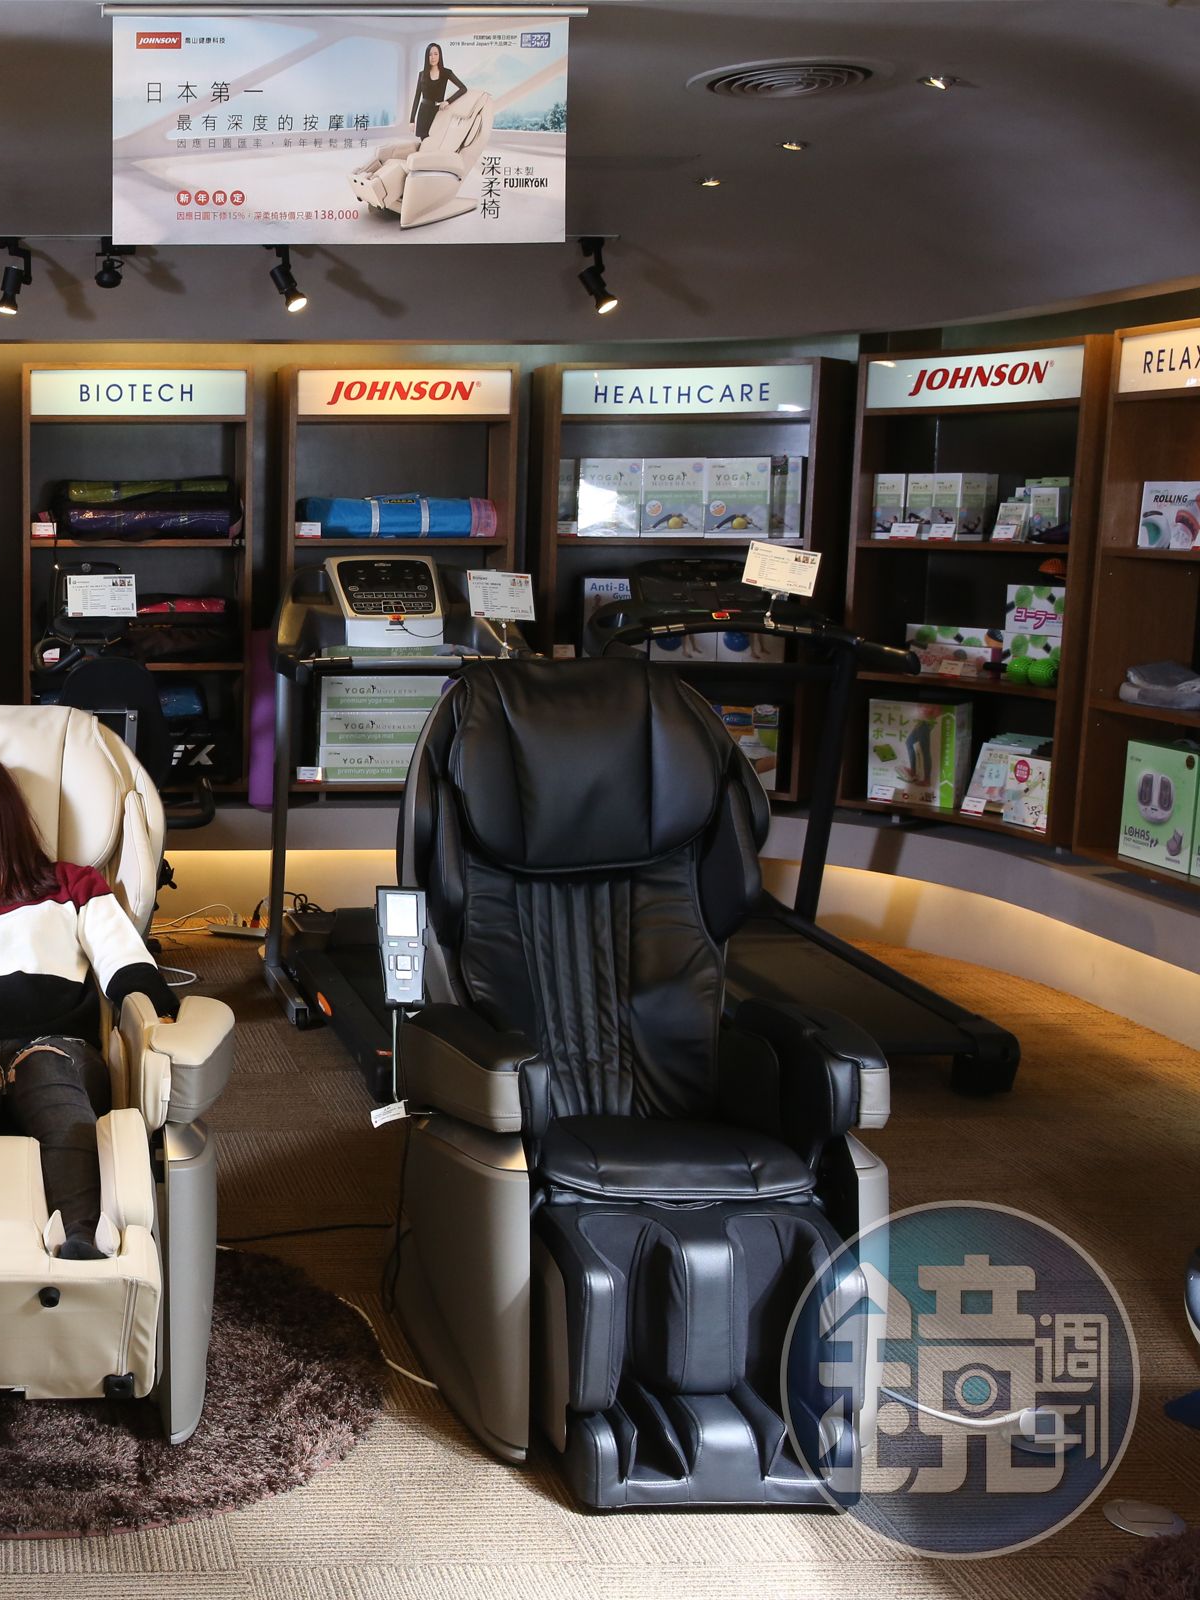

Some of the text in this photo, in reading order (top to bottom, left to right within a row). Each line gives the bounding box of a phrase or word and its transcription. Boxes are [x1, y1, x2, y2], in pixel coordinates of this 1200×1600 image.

[147, 82, 264, 103] 日本第一
[176, 114, 370, 131] 最有深度的按摩椅
[503, 166, 534, 176] 日本製
[481, 156, 501, 220] 深柔椅
[179, 193, 244, 204] 新年限定
[79, 383, 193, 402] BIOTECH
[594, 382, 770, 404] HEALTHCARE
[1153, 494, 1189, 503] ROLLING
[1124, 825, 1151, 841] LOHAS
